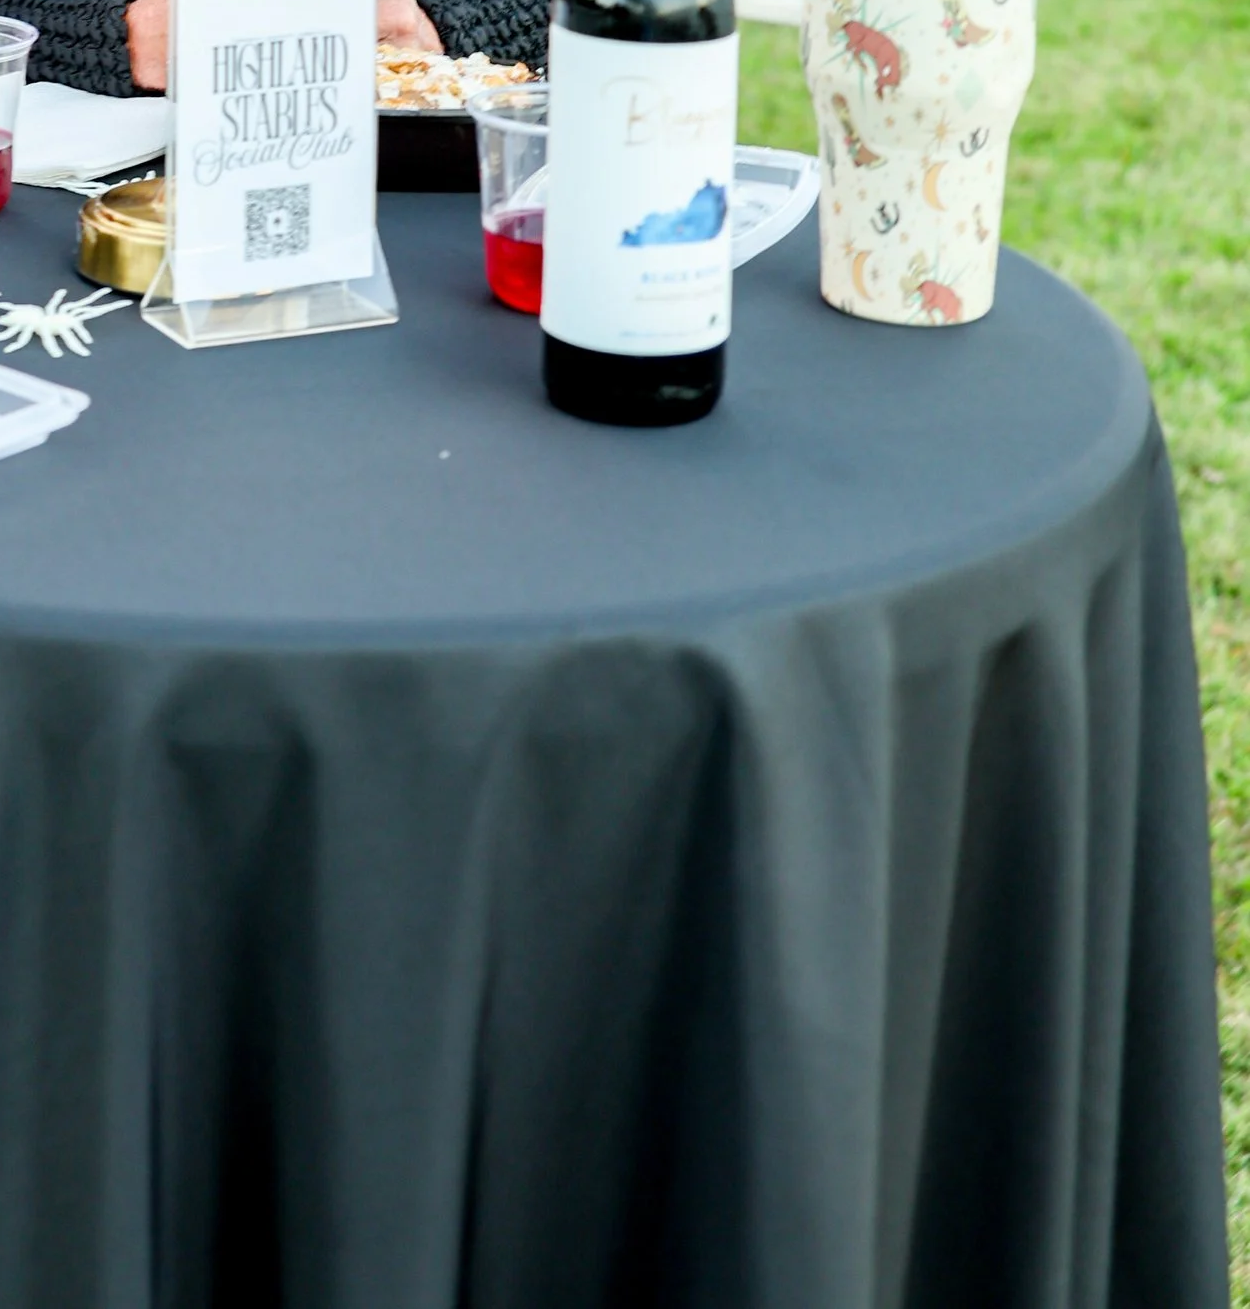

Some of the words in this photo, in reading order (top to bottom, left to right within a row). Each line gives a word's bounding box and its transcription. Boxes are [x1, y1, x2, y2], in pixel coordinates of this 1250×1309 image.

[212, 34, 349, 95] HIGHLAND
[221, 85, 339, 142] STABLES
[192, 127, 289, 187] Social
[287, 127, 355, 170] Club
